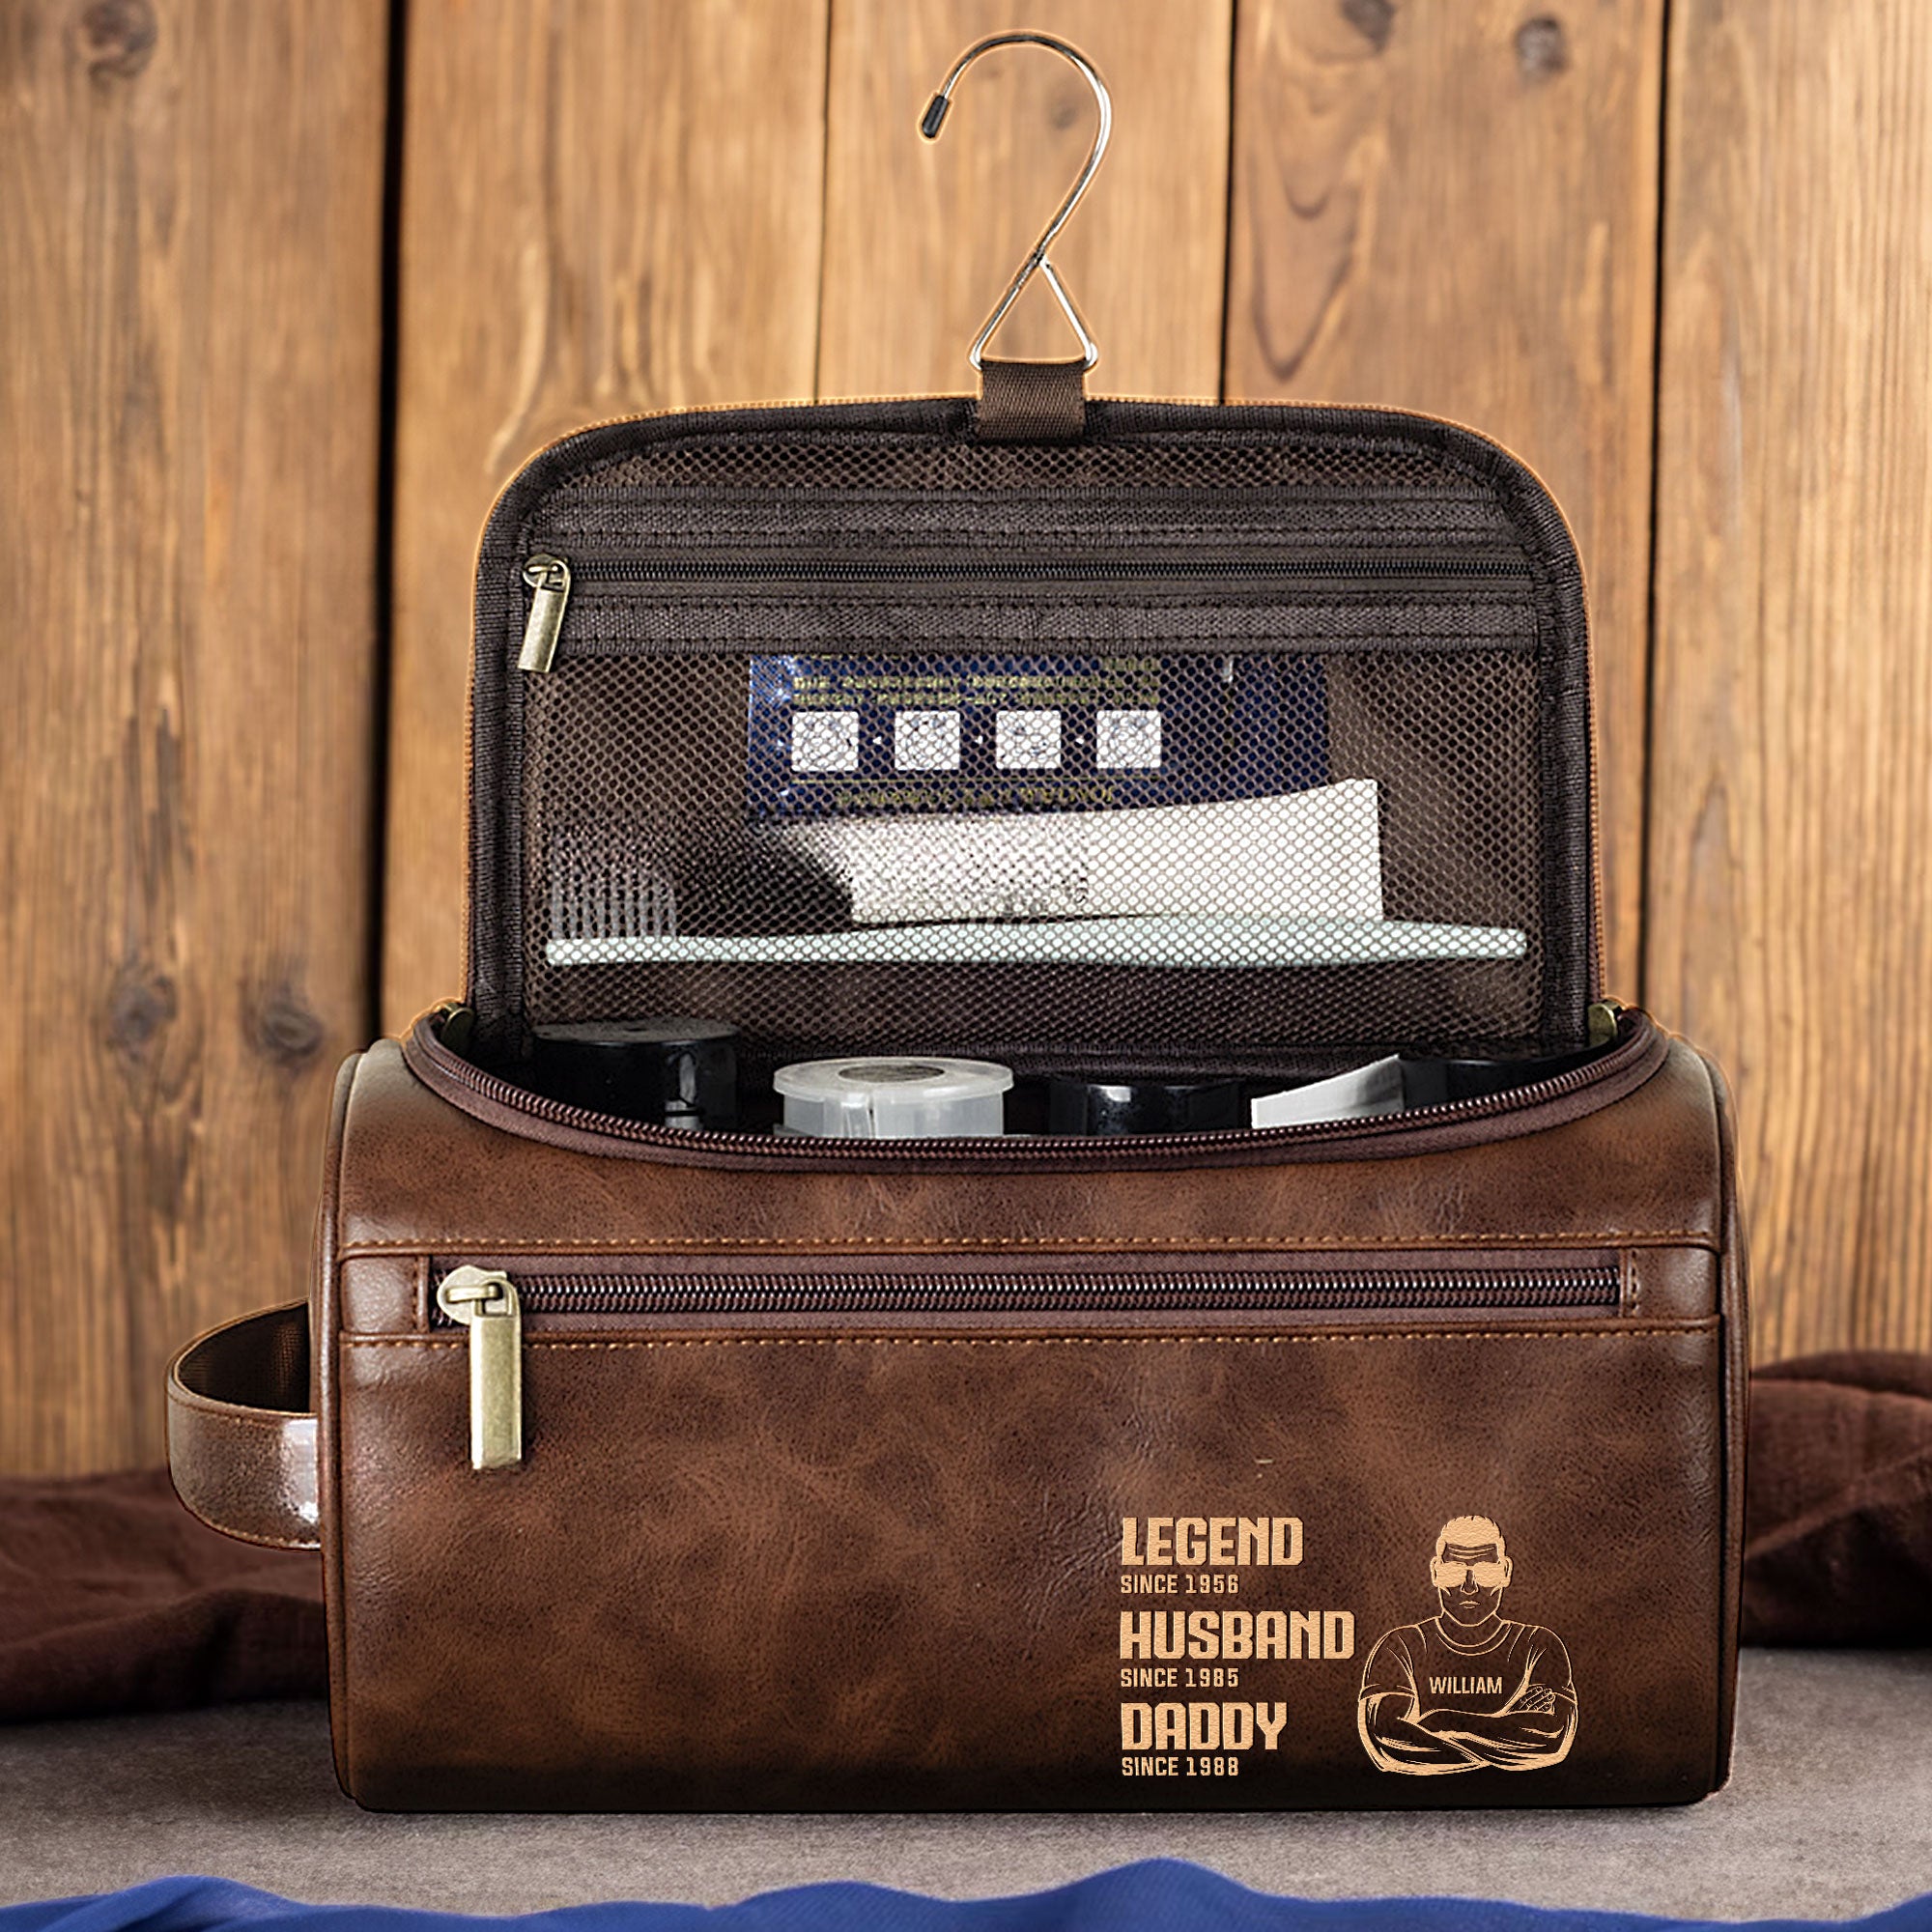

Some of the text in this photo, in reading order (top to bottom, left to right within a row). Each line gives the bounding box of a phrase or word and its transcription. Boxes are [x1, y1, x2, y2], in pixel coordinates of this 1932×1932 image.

[1122, 1517, 1304, 1567] LEGEND
[1121, 1574, 1239, 1594] SINCE 1956
[1120, 1610, 1356, 1661] HUSBAND
[1121, 1667, 1239, 1688] SINCE 1985
[1429, 1676, 1503, 1694] WILLIAM
[1121, 1702, 1288, 1751] DADDY
[1122, 1756, 1239, 1776] SINCE 1988
